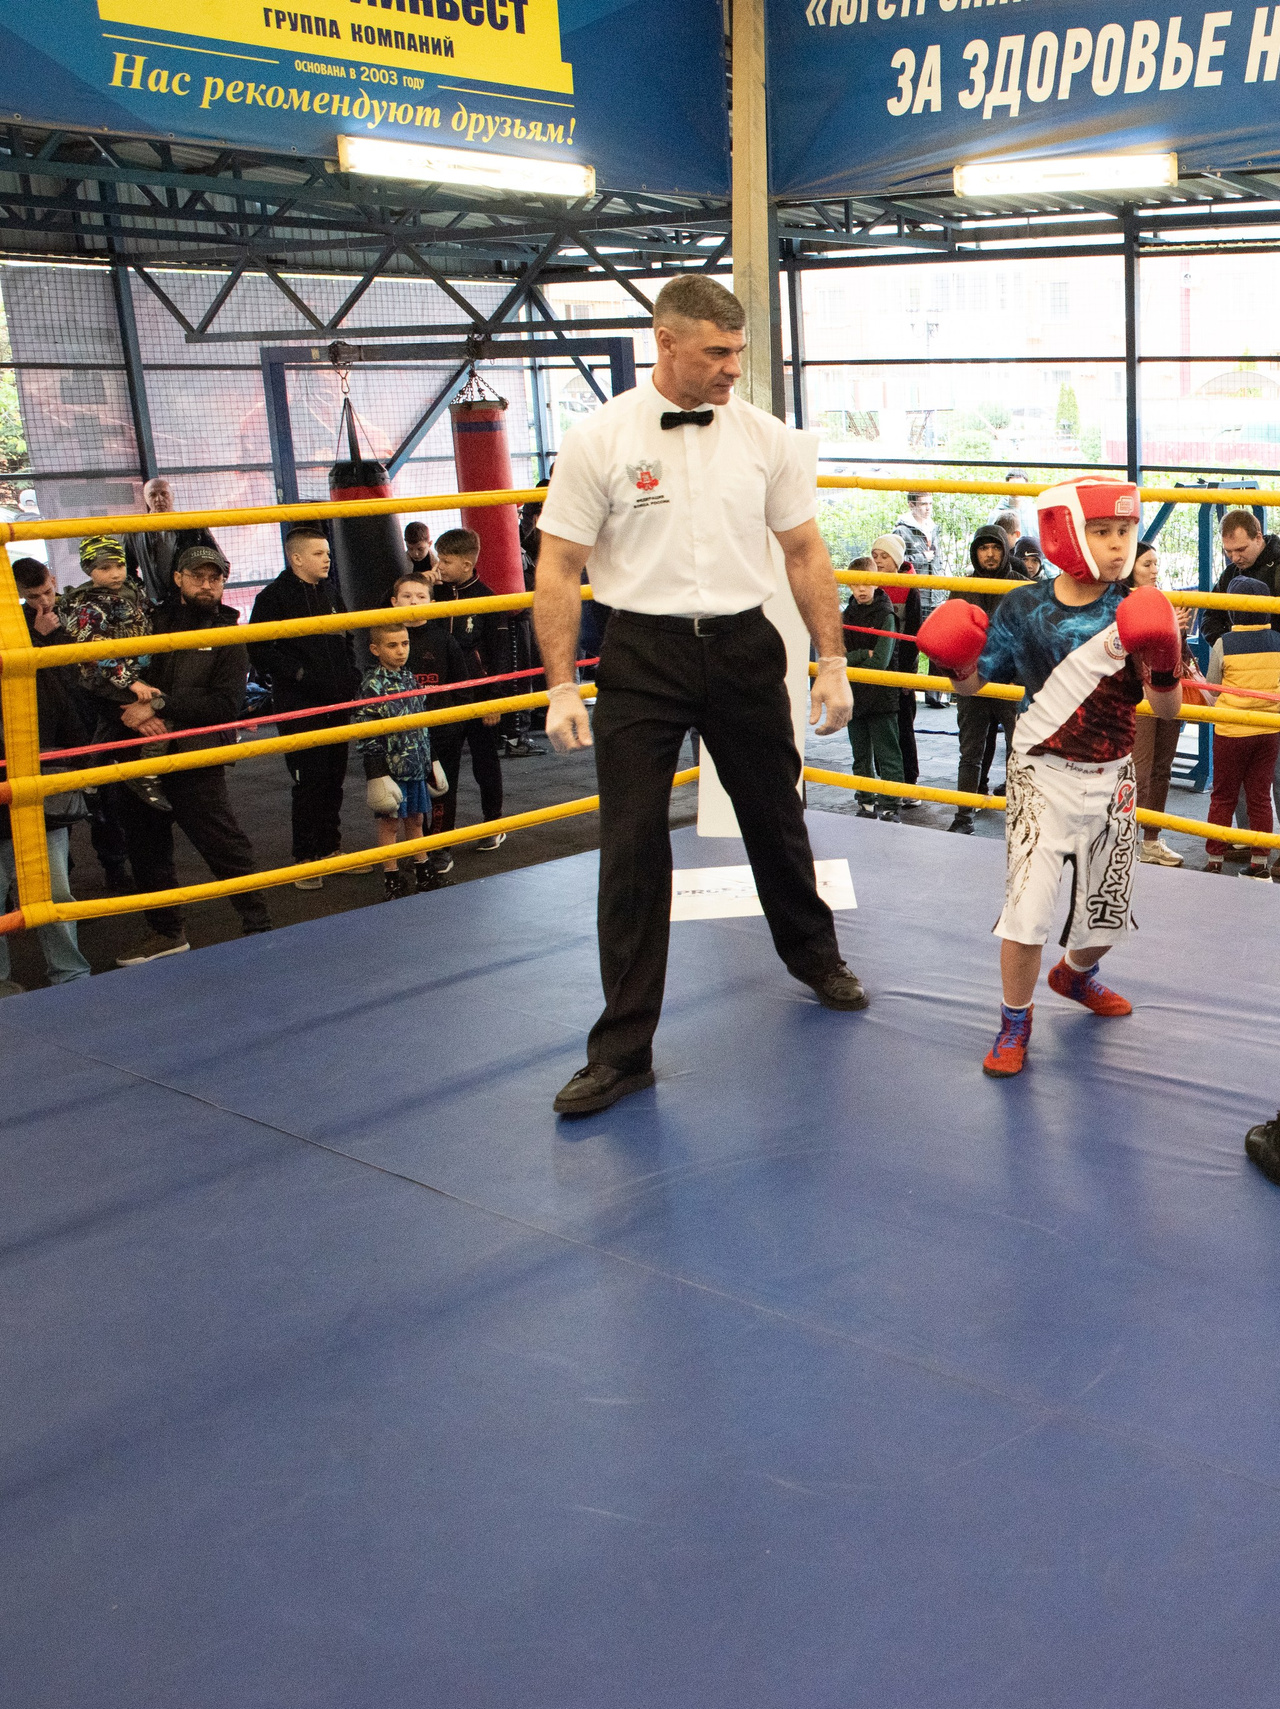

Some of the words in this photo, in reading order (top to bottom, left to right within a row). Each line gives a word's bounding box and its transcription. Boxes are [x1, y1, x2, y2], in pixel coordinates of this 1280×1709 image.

[263, 7, 341, 40] ГРУППА
[350, 22, 455, 58] КОМПАНИЙ
[886, 45, 943, 117] ЗА
[958, 10, 1232, 119] ЗДОРОВЬЕ
[108, 51, 191, 96] Нас
[199, 75, 441, 130] рекомендуют
[451, 102, 577, 146] друзьям!
[294, 59, 346, 79] ОСНОВАНА
[360, 66, 399, 86] 2003
[402, 75, 425, 90] ГОДУ
